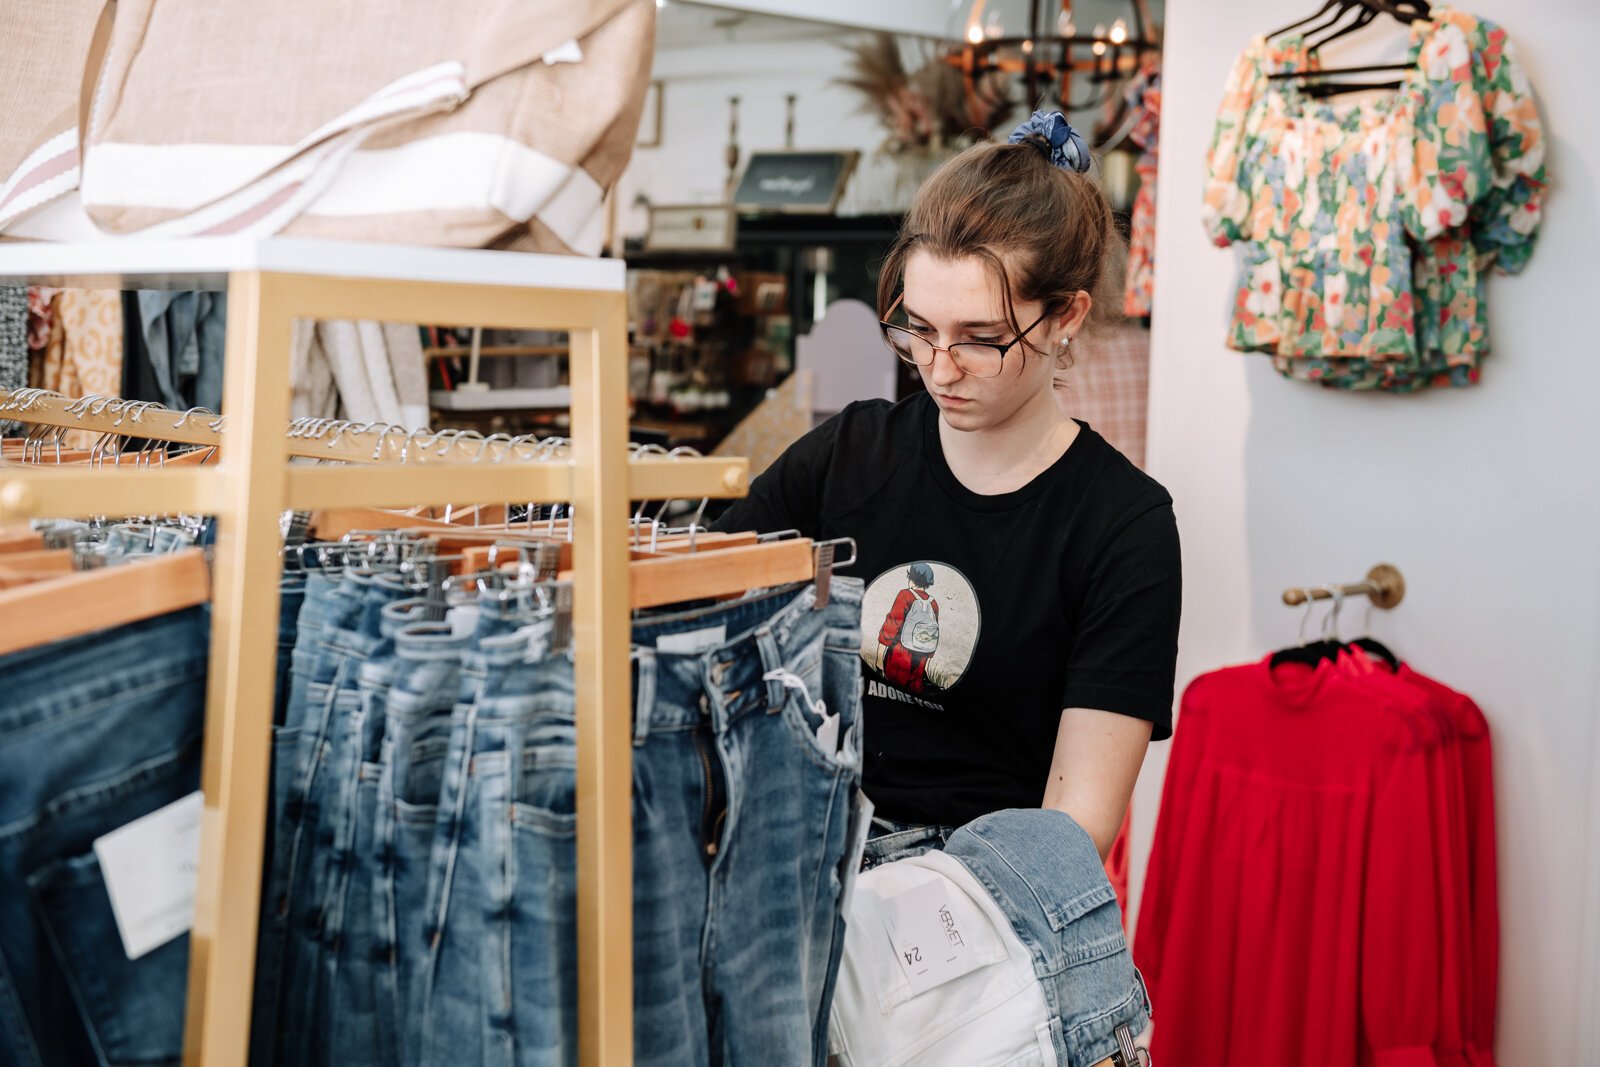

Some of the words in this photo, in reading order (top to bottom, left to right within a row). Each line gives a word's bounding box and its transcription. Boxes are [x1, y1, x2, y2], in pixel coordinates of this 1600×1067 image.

[868, 680, 914, 704] ADORE
[914, 697, 945, 711] YOU
[939, 904, 964, 947] VERVET
[904, 946, 922, 965] 24
